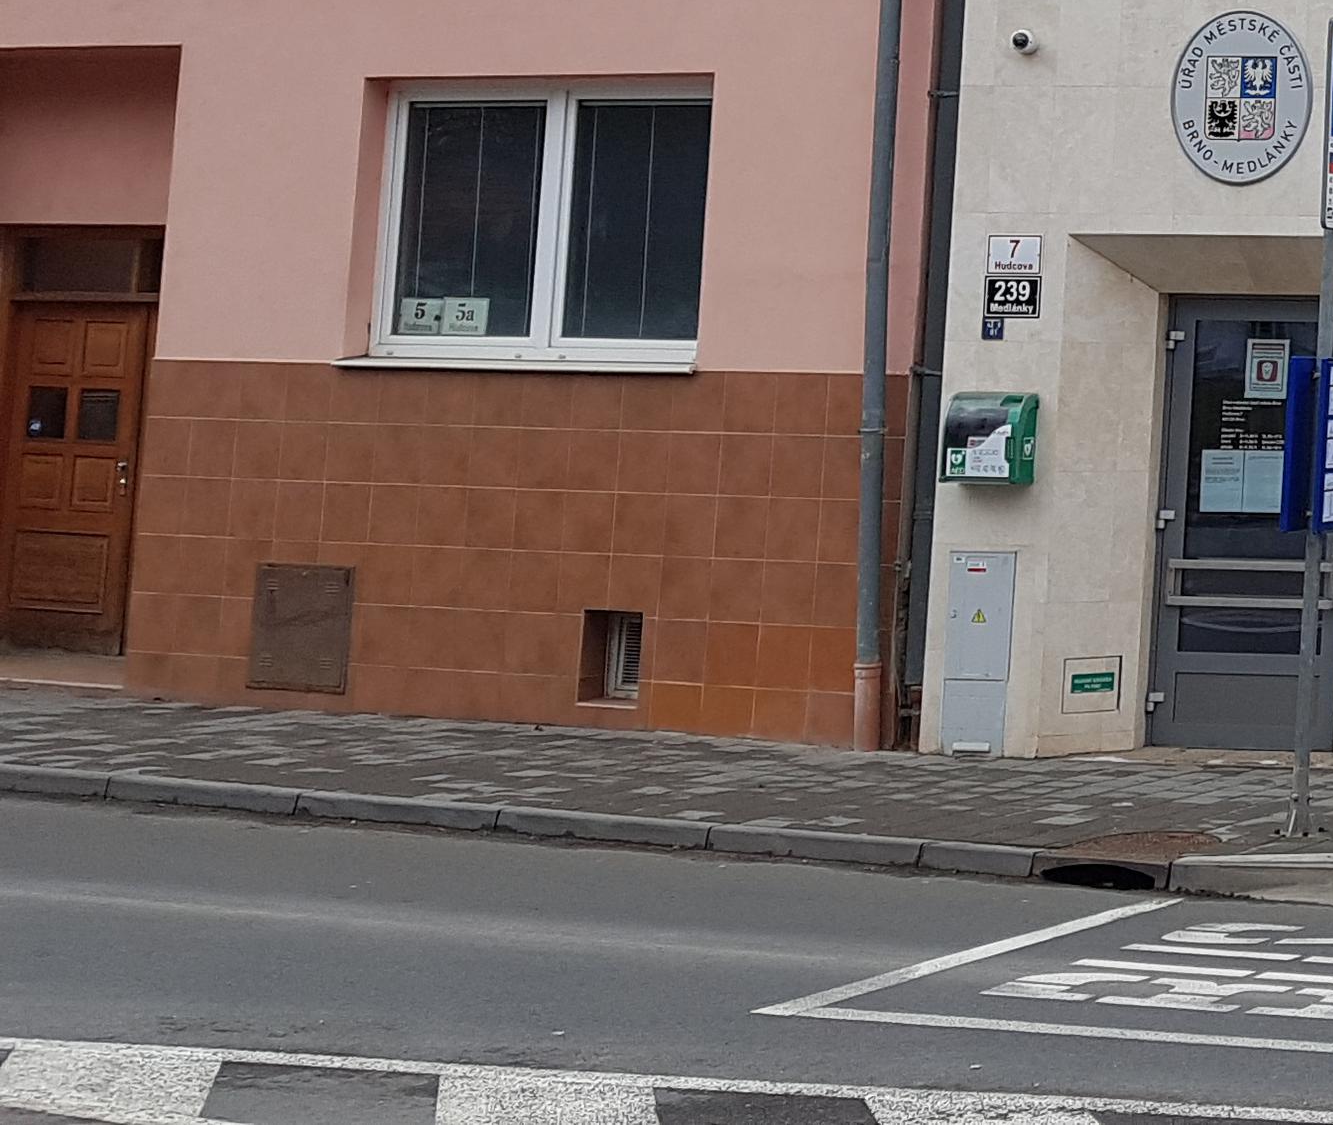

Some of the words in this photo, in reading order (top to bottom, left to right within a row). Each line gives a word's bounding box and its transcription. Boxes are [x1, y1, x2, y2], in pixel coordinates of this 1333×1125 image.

[1178, 46, 1204, 89] ÚŘAD
[1203, 18, 1280, 44] MĚSTSKÉ
[1279, 44, 1303, 89] ČÁSTI
[1009, 239, 1021, 258] 7
[994, 261, 1033, 270] Hudcova
[993, 280, 1031, 301] 239
[414, 302, 427, 319] 5
[455, 302, 475, 321] 5a
[989, 303, 1034, 314] Medlánky
